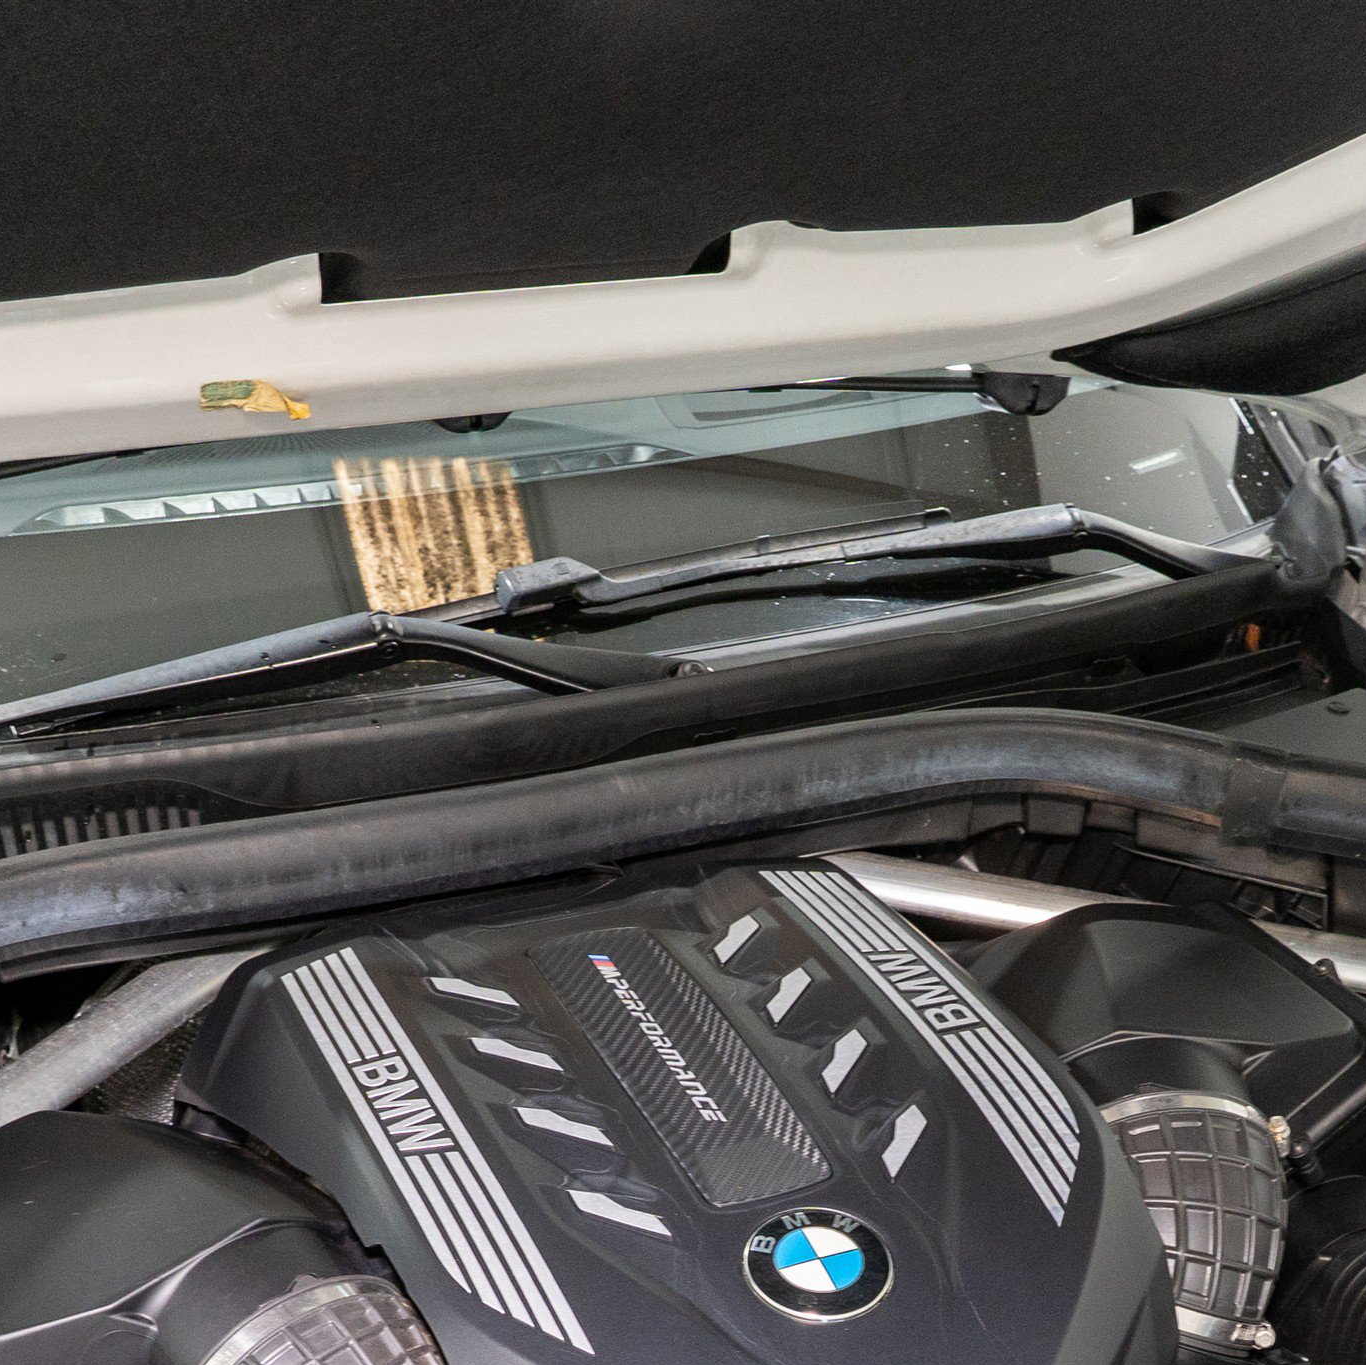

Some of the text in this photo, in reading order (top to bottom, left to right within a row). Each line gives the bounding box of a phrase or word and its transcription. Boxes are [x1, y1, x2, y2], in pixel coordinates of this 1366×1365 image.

[867, 953, 981, 1030] BMW
[351, 1055, 455, 1151] BMW
[750, 1211, 860, 1254] BMW
